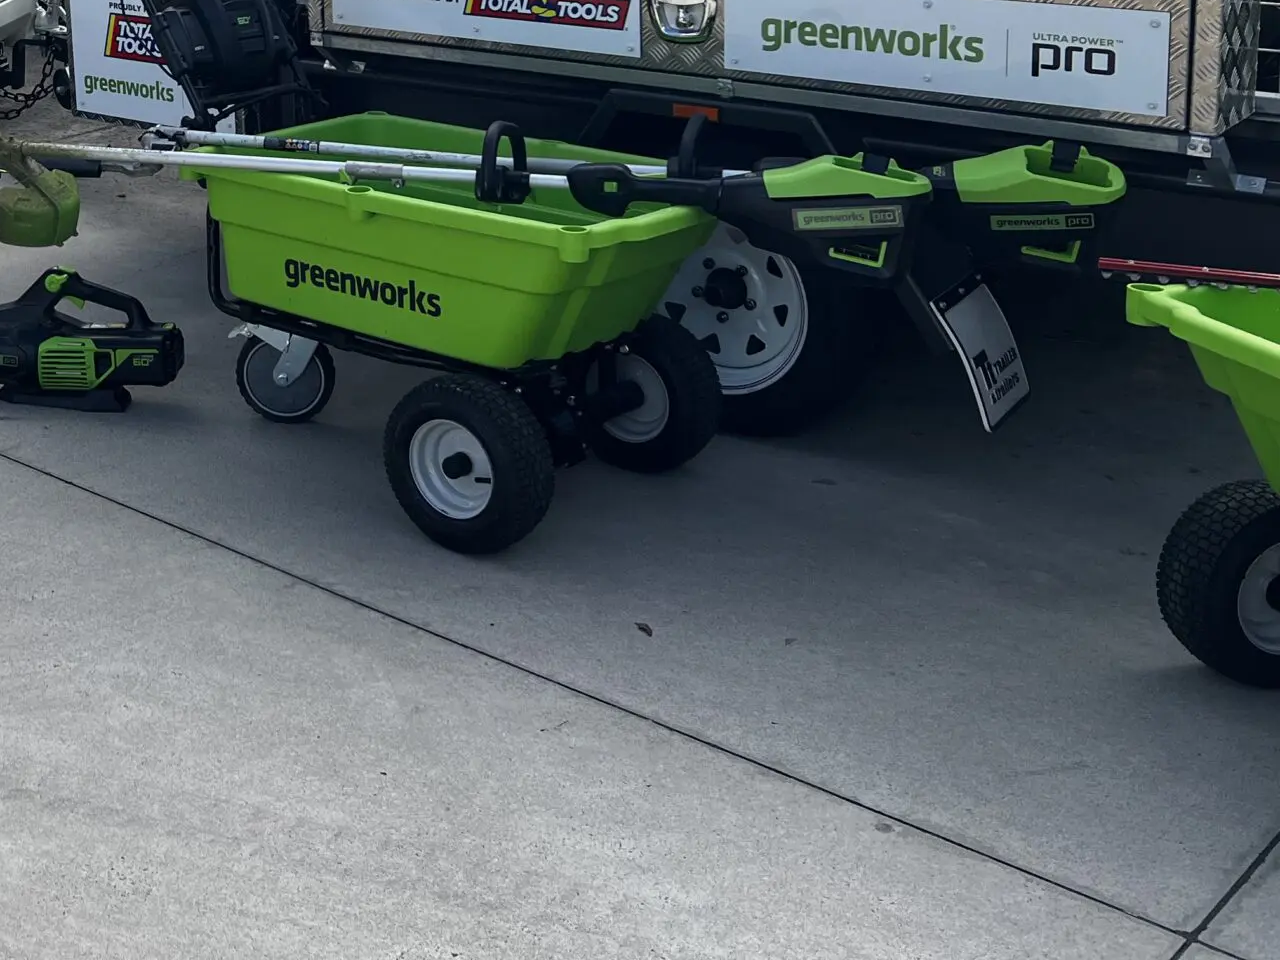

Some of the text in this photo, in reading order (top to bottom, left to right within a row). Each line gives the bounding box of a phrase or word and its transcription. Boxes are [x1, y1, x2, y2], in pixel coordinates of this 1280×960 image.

[557, 1, 620, 22] TOOLS
[118, 20, 154, 40] TOTA
[761, 16, 984, 64] greenworks
[1032, 32, 1069, 43] ULTRA
[1031, 42, 1116, 77] pro
[84, 75, 175, 102] greenworks
[803, 211, 894, 226] greenworks pro
[996, 215, 1090, 228] greenworks pro
[284, 257, 442, 319] greenworks
